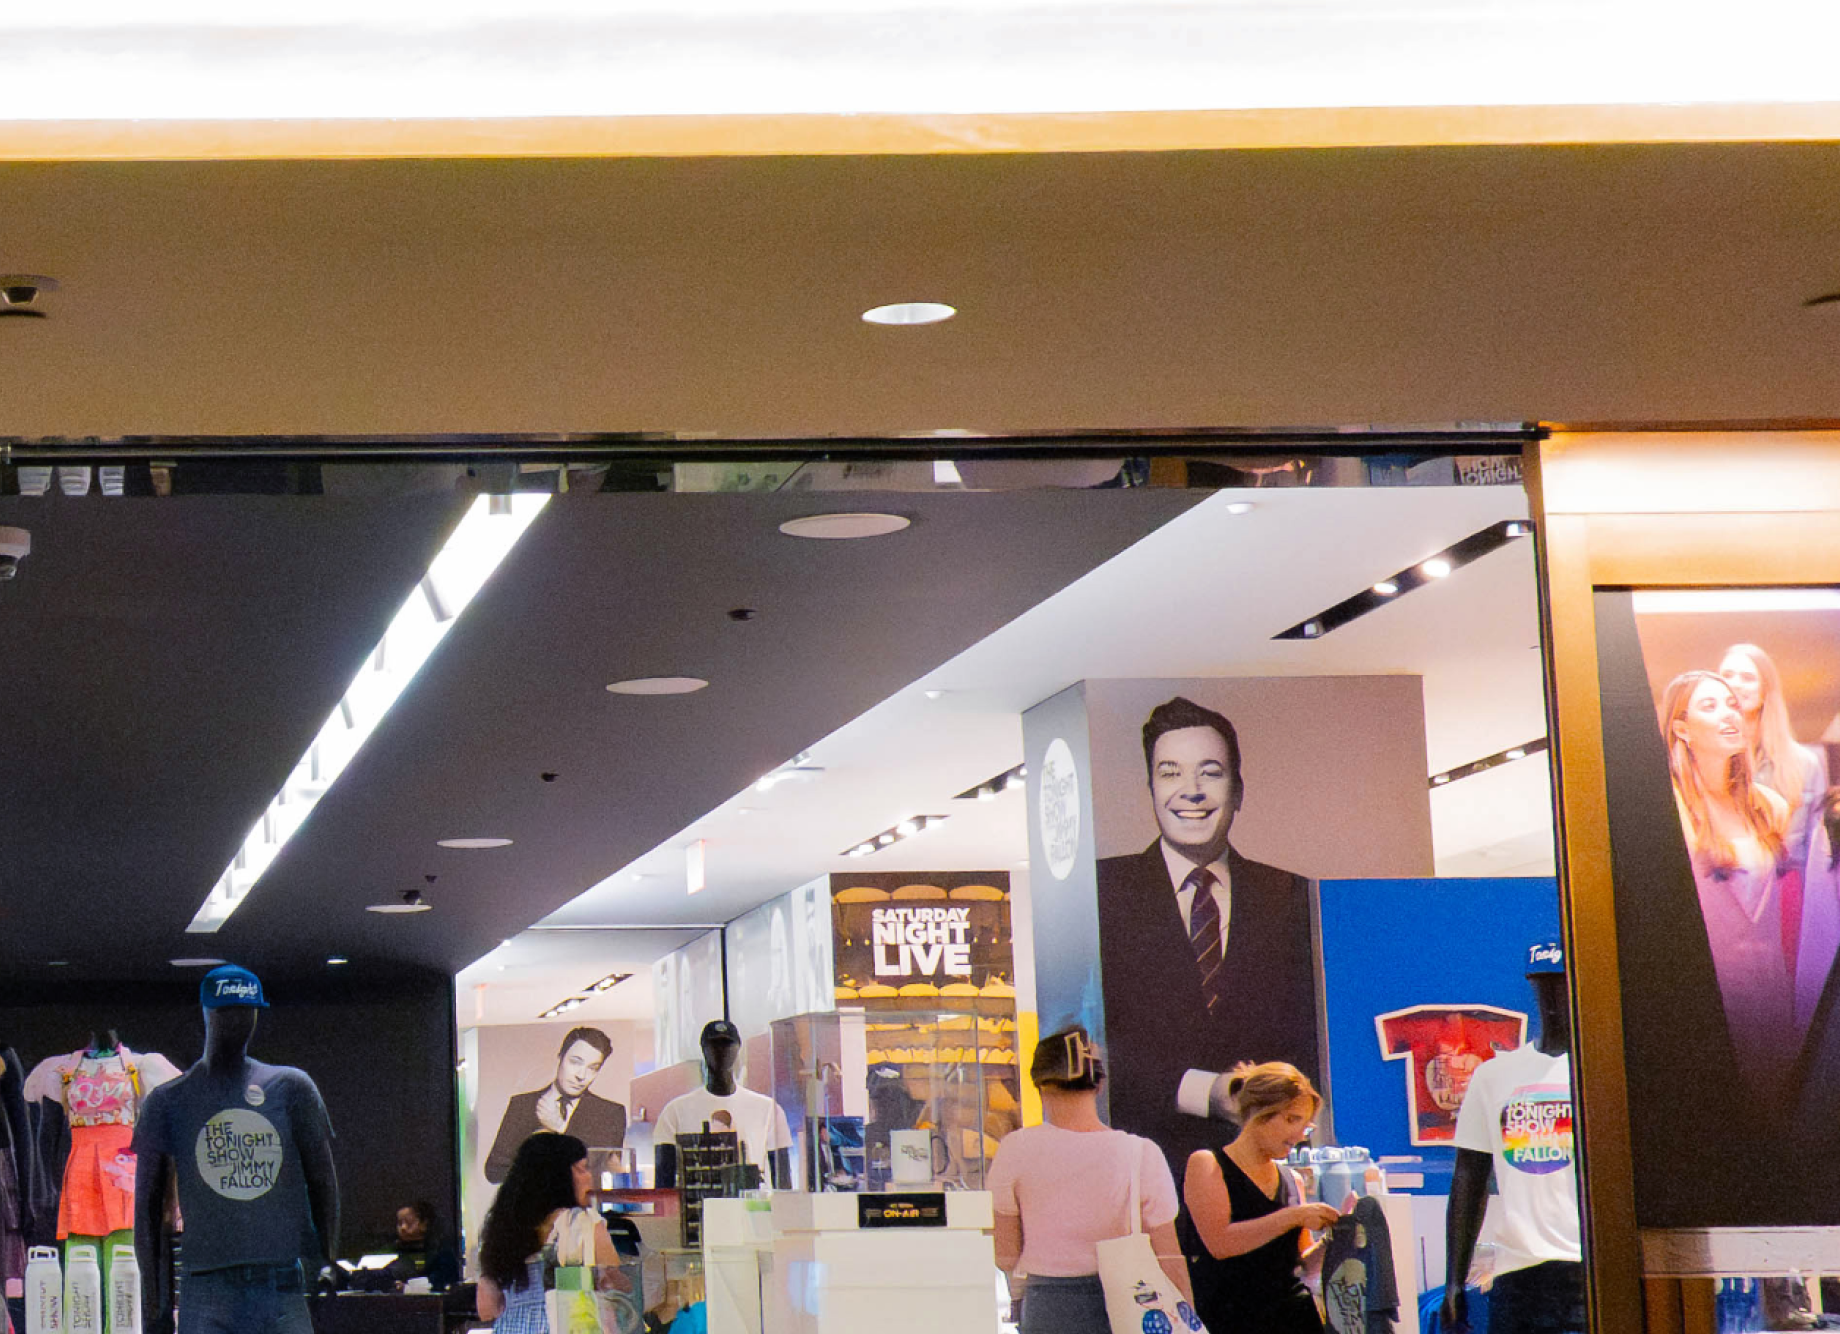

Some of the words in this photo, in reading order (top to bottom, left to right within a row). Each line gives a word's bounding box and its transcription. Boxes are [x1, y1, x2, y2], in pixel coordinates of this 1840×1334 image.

[872, 907, 971, 923] SATURDAY
[872, 922, 971, 945] NIGHT
[874, 943, 973, 976] LIVE
[215, 978, 259, 998] Tonight
[205, 1121, 234, 1136] THE
[1505, 1118, 1557, 1135] SHOW
[205, 1132, 274, 1150] TONIGHT
[207, 1147, 255, 1165] SHOW
[232, 1160, 275, 1180] JIMMY
[220, 1174, 274, 1190] FALLON
